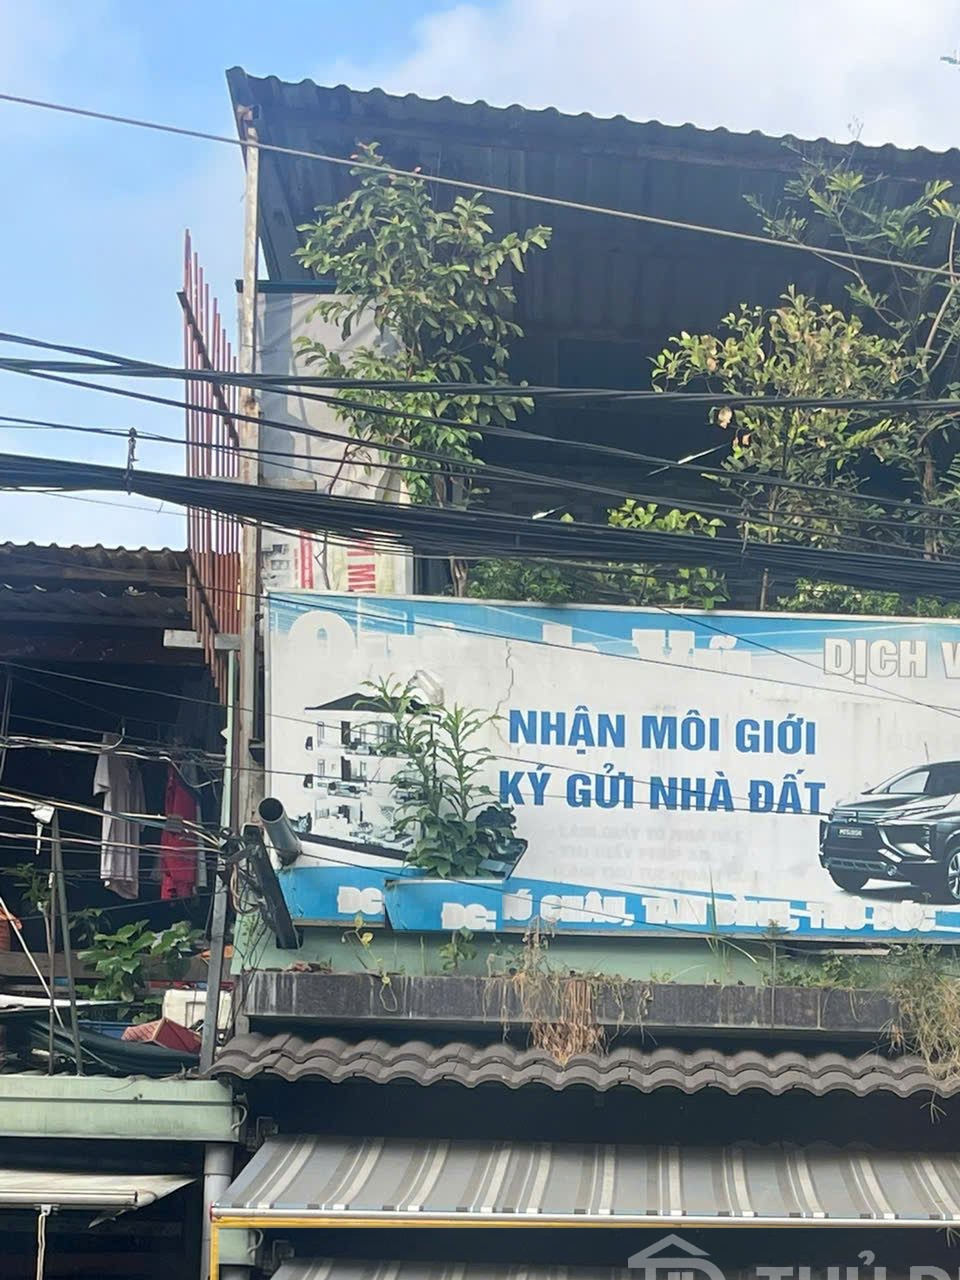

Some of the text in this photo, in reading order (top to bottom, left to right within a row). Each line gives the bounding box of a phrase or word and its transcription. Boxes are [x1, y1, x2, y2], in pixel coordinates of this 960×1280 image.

[823, 637, 929, 685] DỊCH
[508, 705, 817, 755] NHẬN MÔI GIỚI
[500, 762, 827, 815] KÝ GỬI NHÀ ĐẤT
